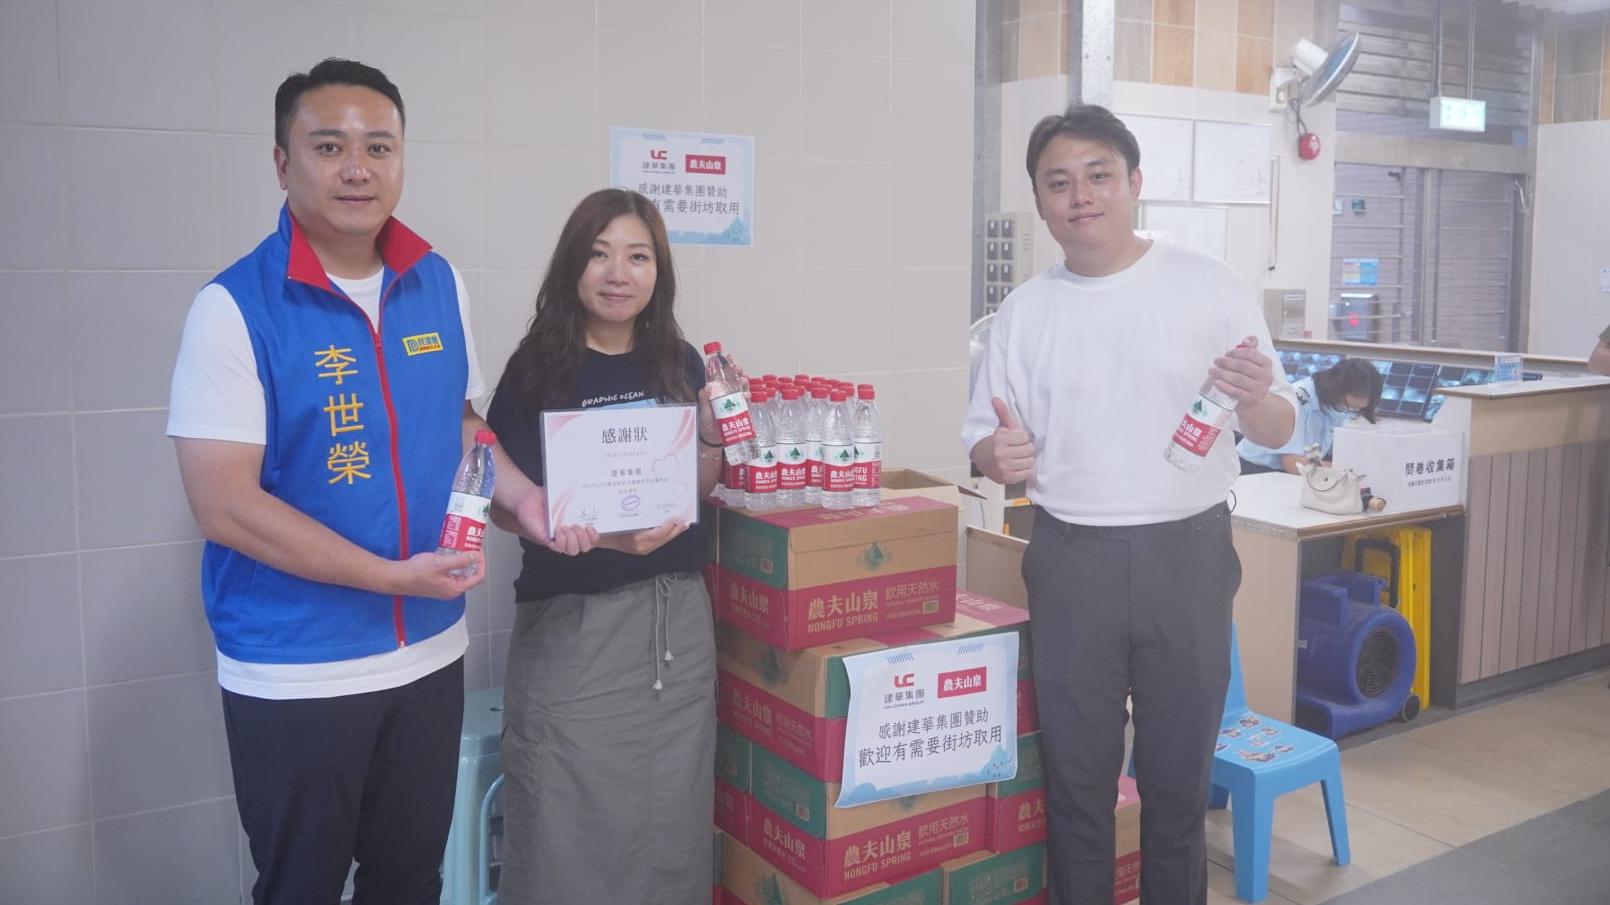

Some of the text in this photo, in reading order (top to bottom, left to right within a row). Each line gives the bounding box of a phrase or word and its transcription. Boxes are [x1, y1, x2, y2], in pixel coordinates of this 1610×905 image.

[314, 344, 372, 485] 李世榮
[601, 425, 648, 444] 感謝狀
[1405, 458, 1455, 476] 問卷收集箱
[885, 579, 940, 601] 飲用天然水
[807, 590, 879, 621] 農夫山泉
[808, 619, 843, 634] NONGFU
[846, 612, 879, 627] SPRING
[943, 674, 982, 692] 農夫山泉
[884, 688, 925, 704] 建華集團
[879, 707, 989, 740] 感謝建華集團贊助
[858, 725, 1002, 769] 歡迎有需要街坊取用
[917, 814, 970, 838] 飲用天然水
[844, 829, 912, 868] 農夫山泉
[844, 850, 912, 882] NONGFU SPRING
